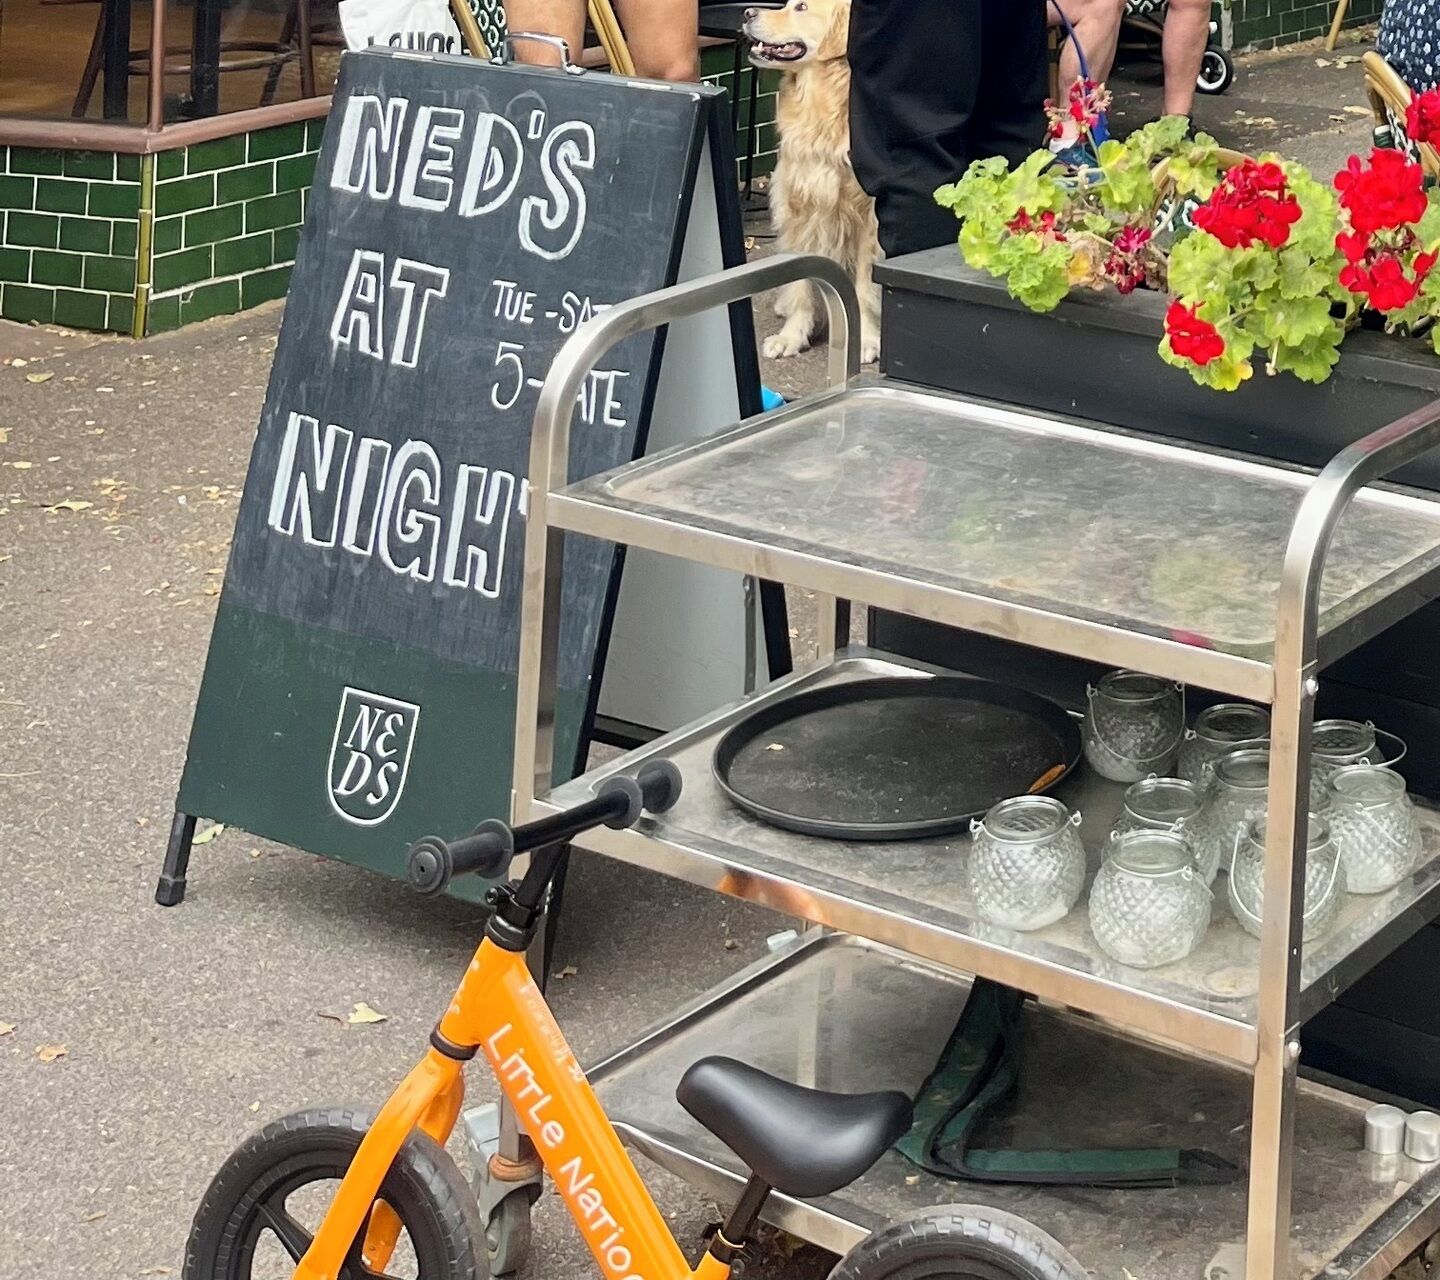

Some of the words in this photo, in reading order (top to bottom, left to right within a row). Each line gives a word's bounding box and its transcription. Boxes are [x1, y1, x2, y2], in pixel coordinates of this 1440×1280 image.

[330, 95, 596, 260] NED'S
[330, 248, 450, 368] AT
[492, 279, 537, 324] TUE
[268, 411, 529, 598] NIGH
